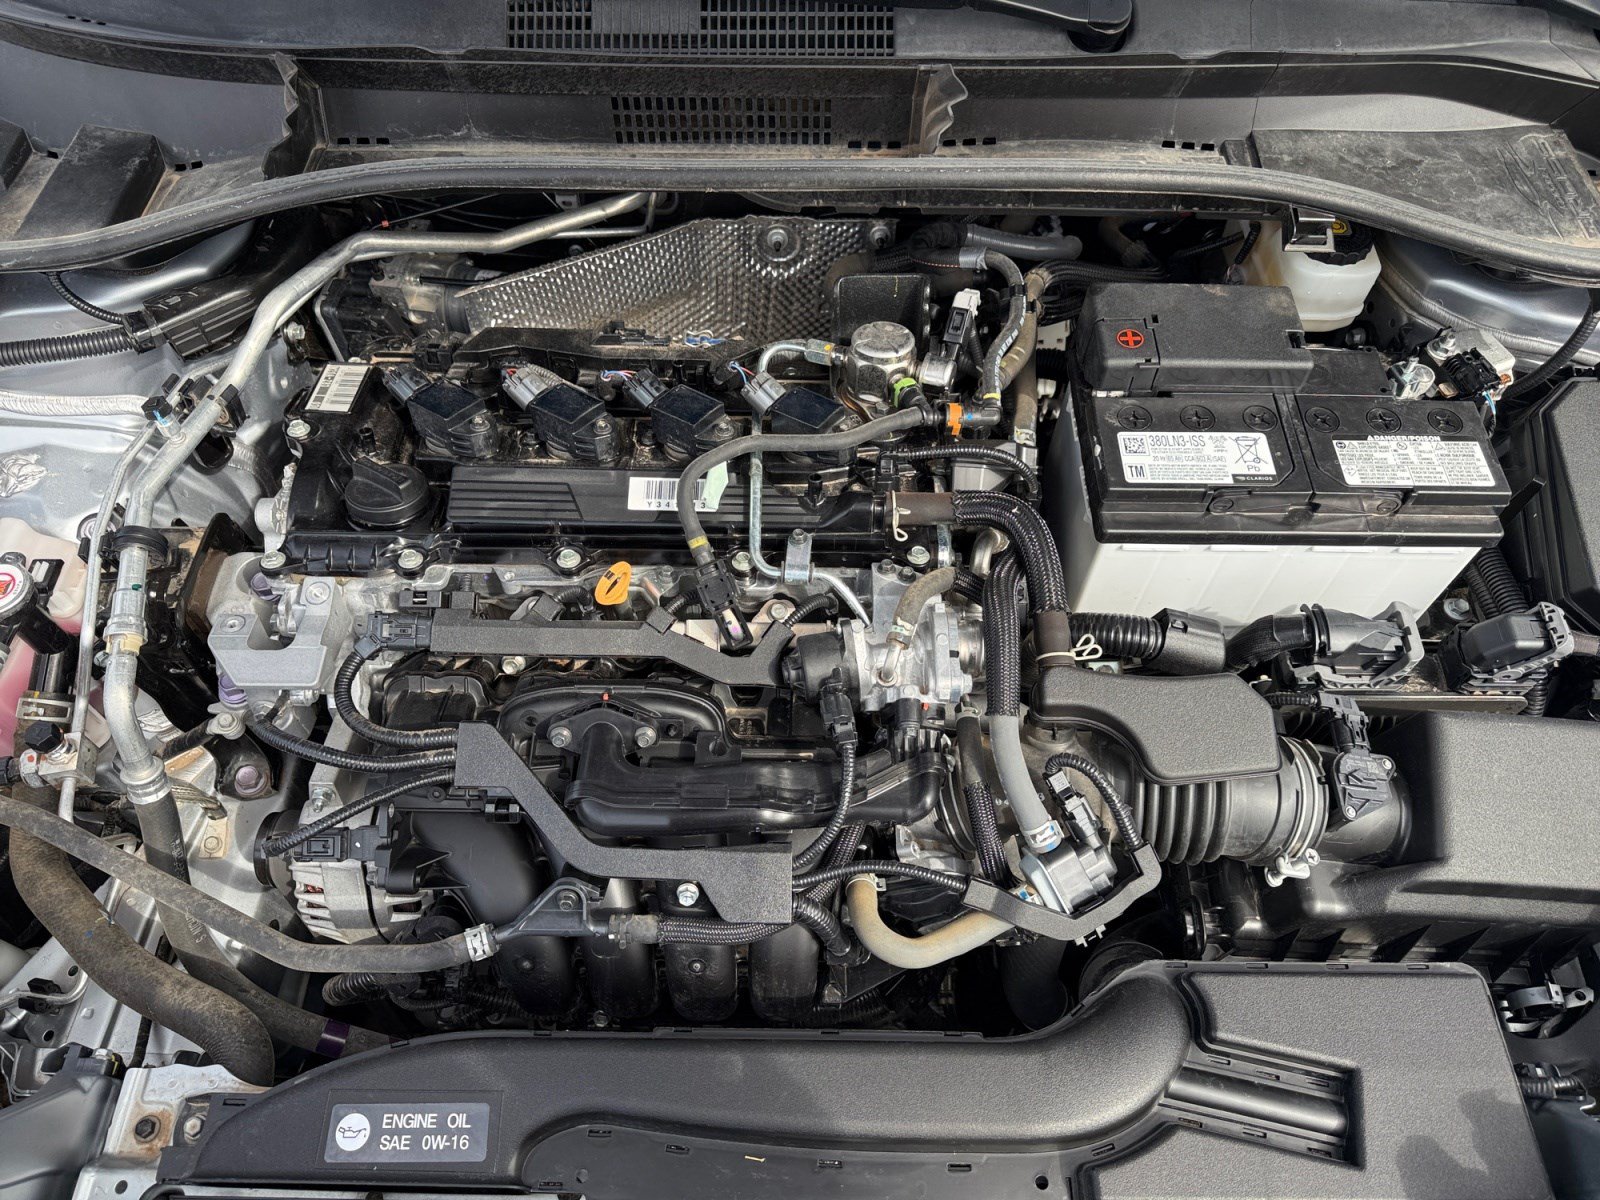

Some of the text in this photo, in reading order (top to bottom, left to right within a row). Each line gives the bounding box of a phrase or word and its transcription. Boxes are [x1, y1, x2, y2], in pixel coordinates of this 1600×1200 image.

[1149, 435, 1206, 447] 380LN3-ISS
[1127, 465, 1145, 478] TM
[1246, 464, 1261, 472] Pb
[382, 1113, 471, 1129] ENGINE OIL
[379, 1135, 470, 1151] SAE 0W-16
